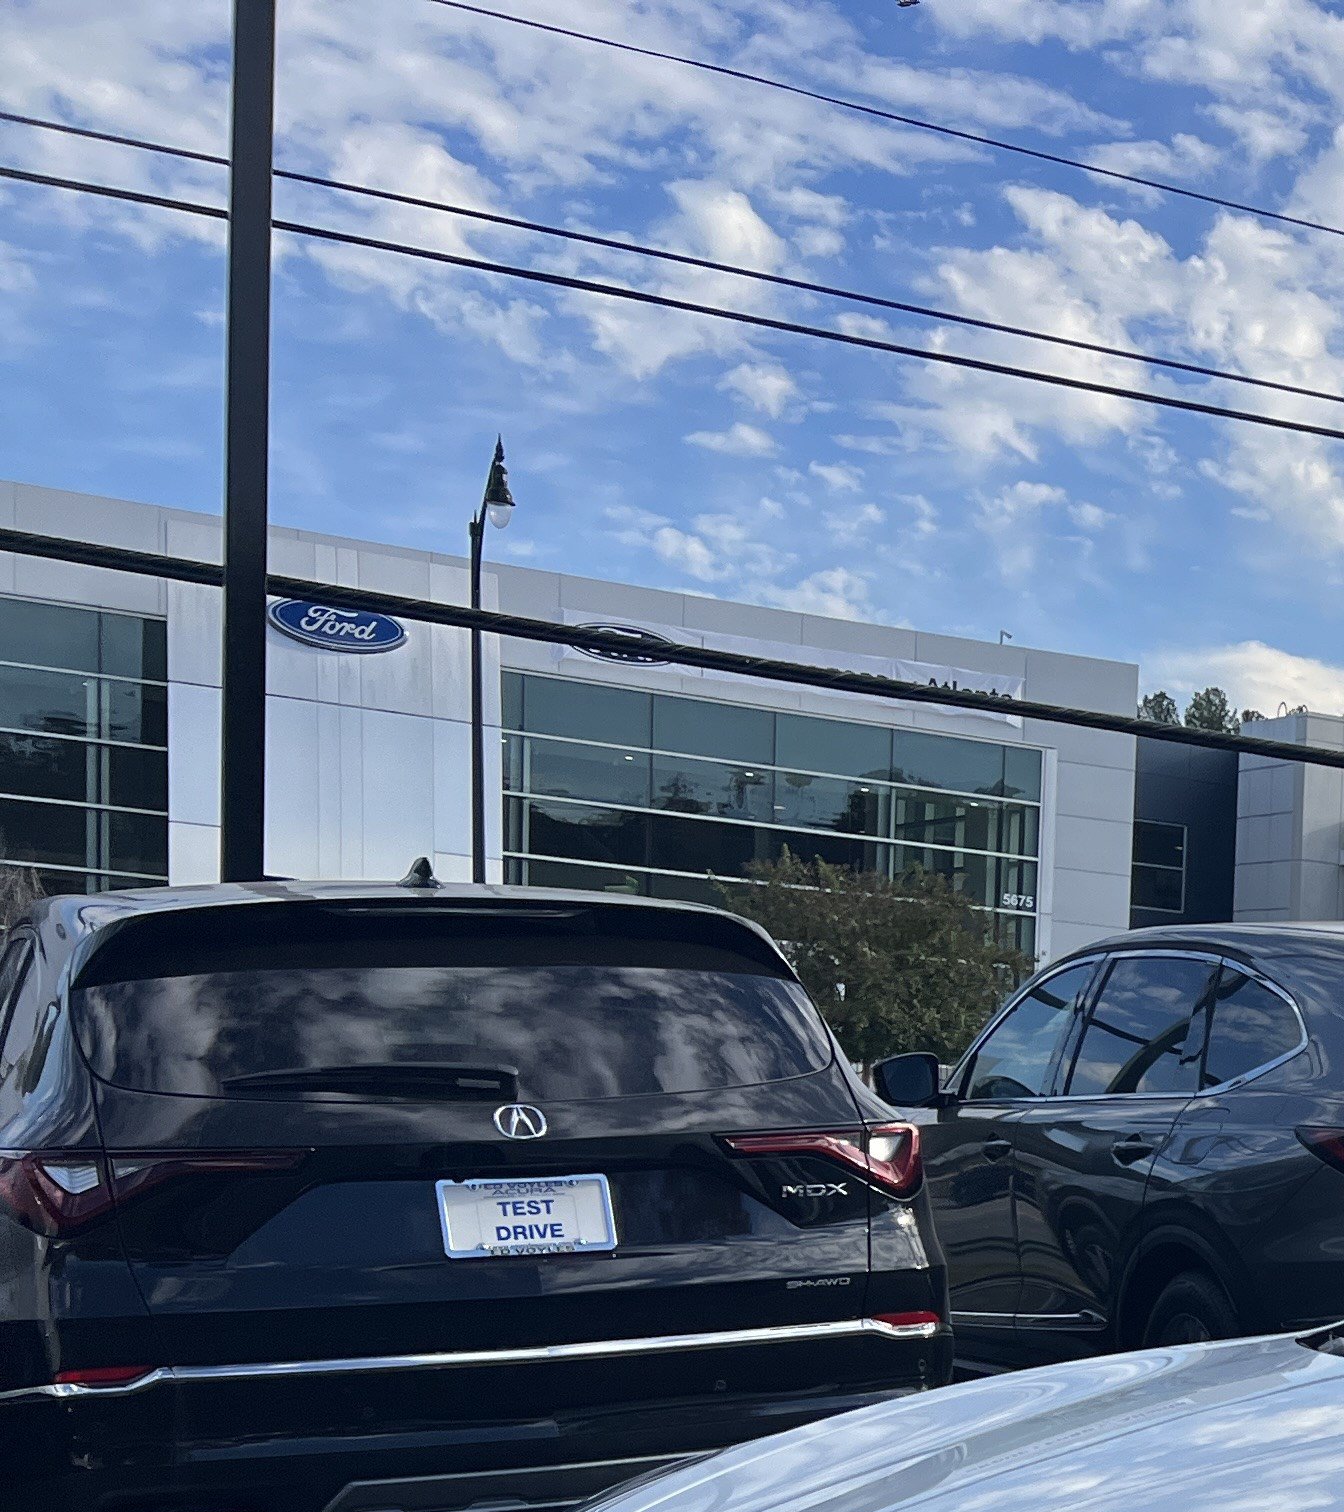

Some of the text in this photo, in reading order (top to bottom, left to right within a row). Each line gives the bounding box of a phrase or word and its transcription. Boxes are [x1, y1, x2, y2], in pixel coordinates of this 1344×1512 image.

[300, 606, 376, 640] Ford
[1003, 893, 1034, 908] 5675
[782, 1182, 848, 1198] MDX
[497, 1200, 555, 1217] TEST
[495, 1223, 565, 1241] DRIVE
